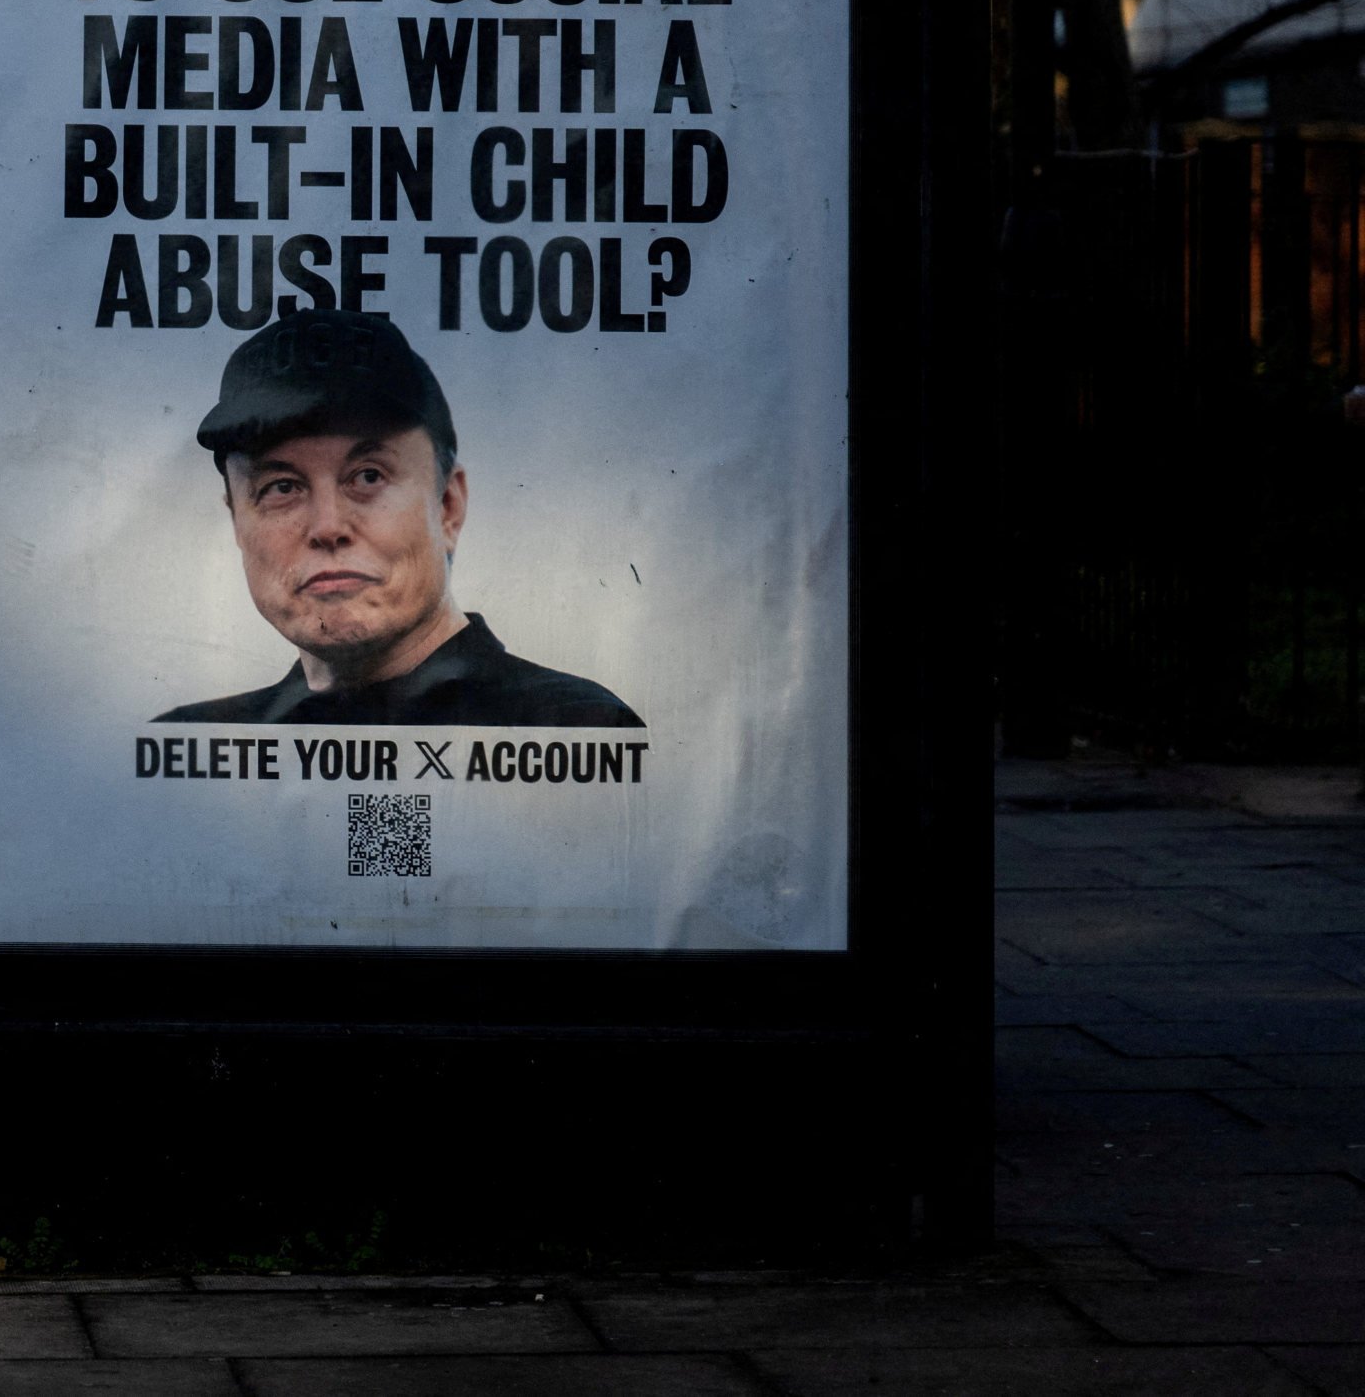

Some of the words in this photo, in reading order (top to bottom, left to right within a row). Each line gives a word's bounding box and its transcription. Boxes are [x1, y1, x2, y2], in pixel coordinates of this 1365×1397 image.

[83, 15, 364, 111] MEDIA
[398, 17, 615, 113] WITH
[653, 20, 712, 114] A
[64, 124, 433, 221] BUILT-IN
[471, 127, 728, 223] CHILD
[95, 234, 390, 332] ABUSE
[424, 236, 691, 333] TOOL?
[136, 738, 279, 779] DELETE
[294, 739, 397, 780] YOUR
[466, 741, 649, 783] ACCOUNT
